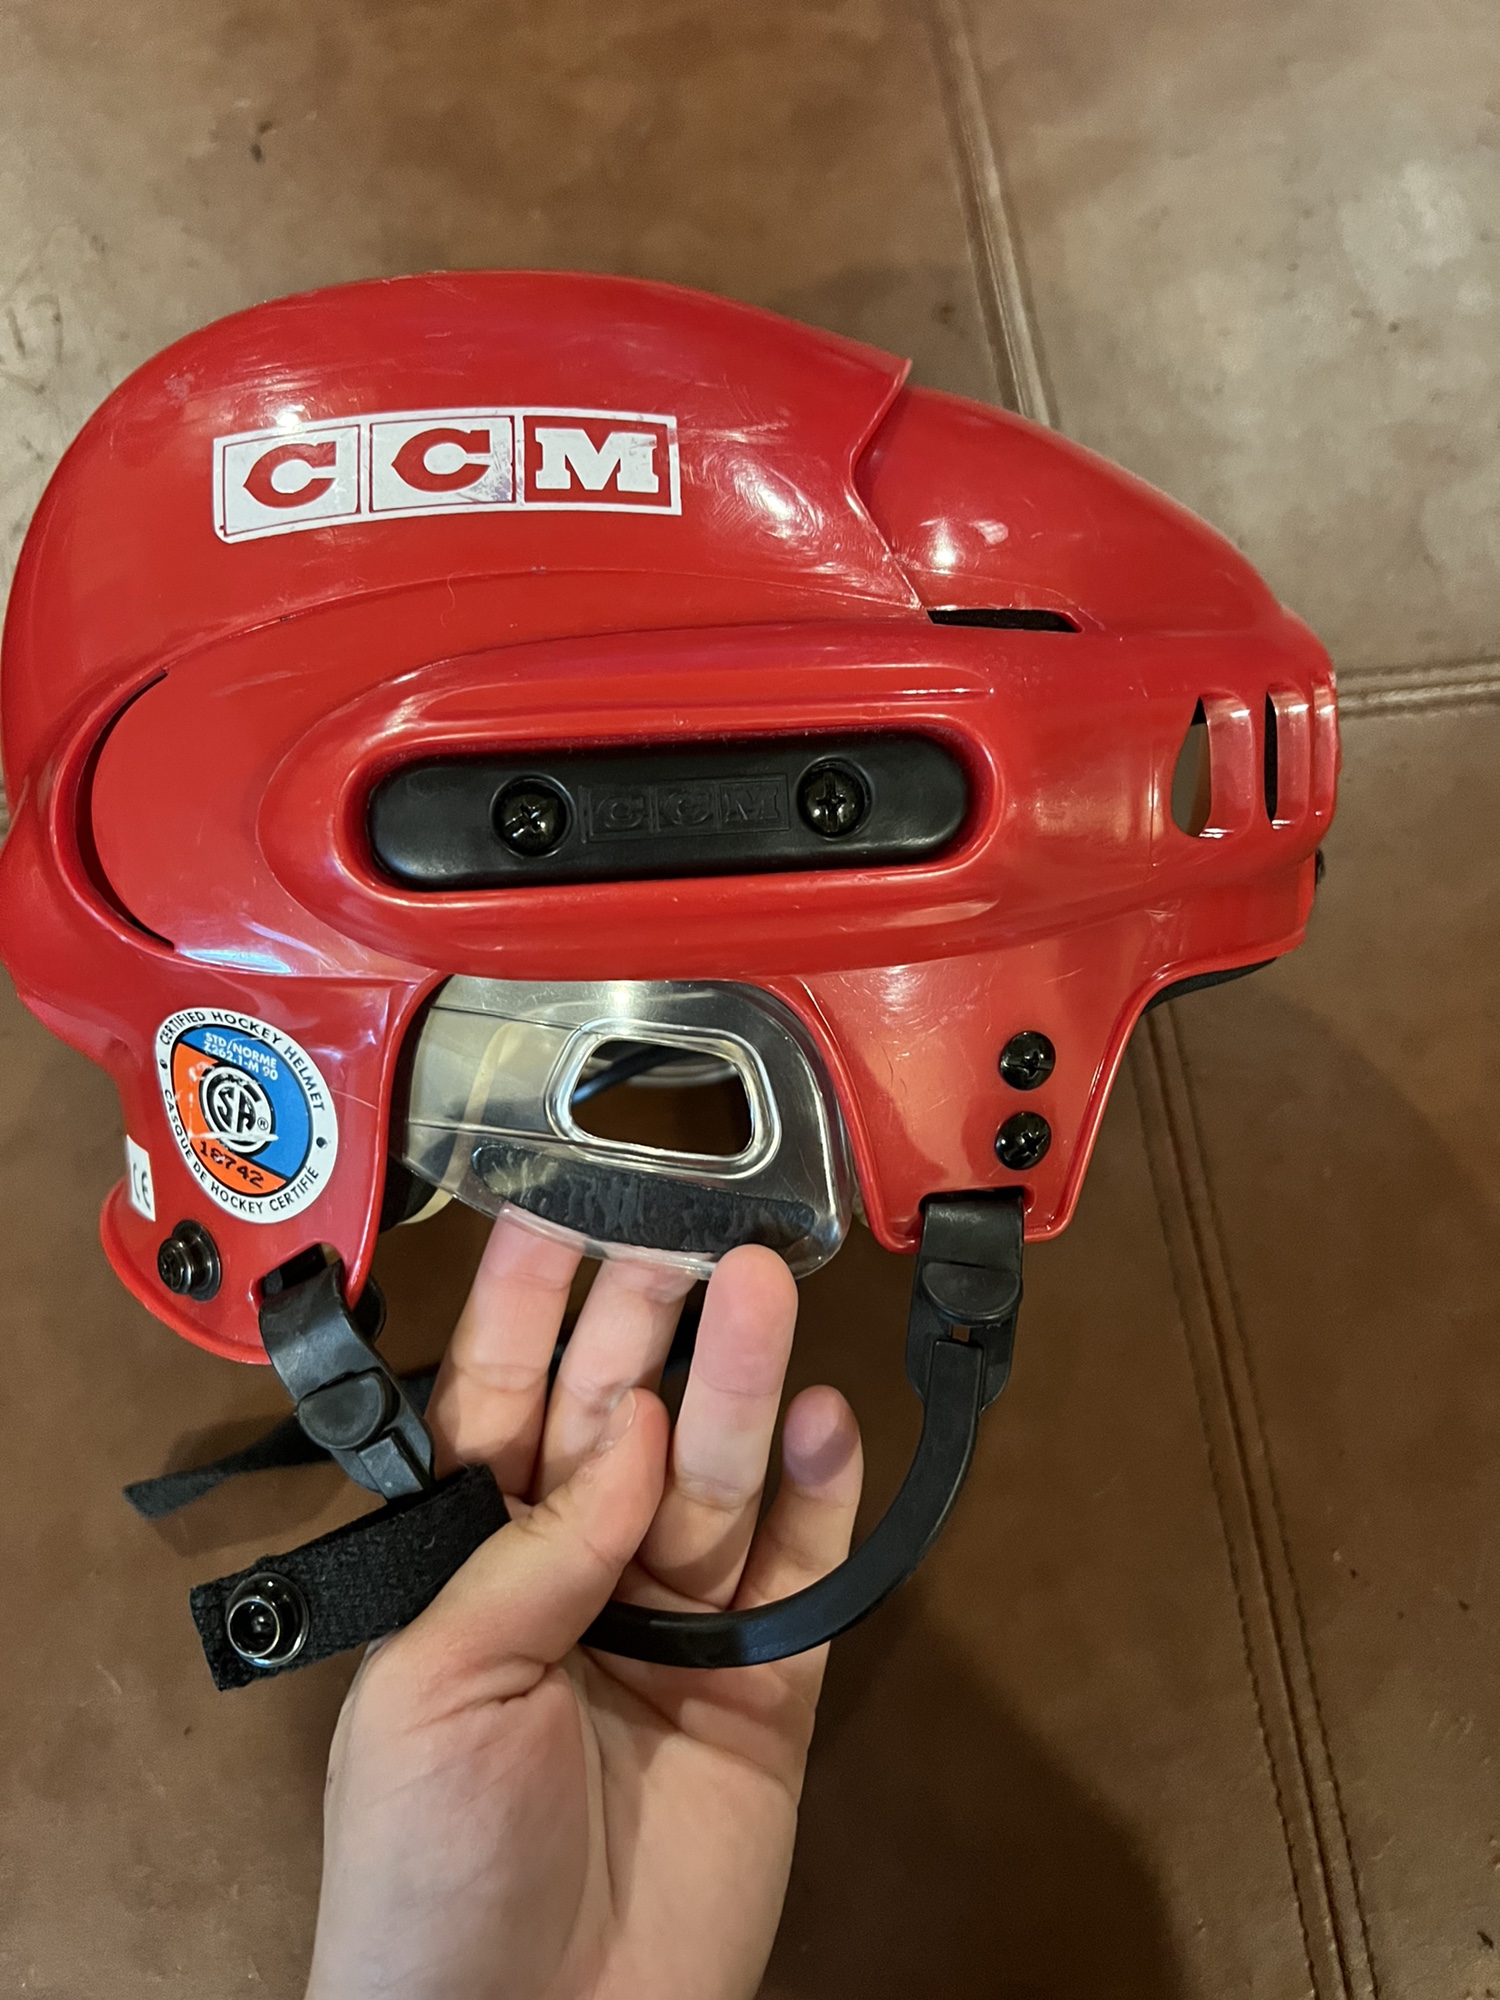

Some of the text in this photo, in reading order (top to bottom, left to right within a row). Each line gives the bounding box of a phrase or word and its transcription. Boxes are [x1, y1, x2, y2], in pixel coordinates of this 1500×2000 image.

[243, 427, 659, 509] CCM
[597, 786, 780, 829] CCM
[159, 1011, 325, 1112] CERTIFIED HOCKEY HELMET
[205, 1032, 278, 1070] STD/NORME
[164, 1089, 193, 1160] CASQUE
[193, 1161, 208, 1183] DE
[211, 1182, 263, 1215] HOCKEY
[200, 1141, 265, 1190] 18742
